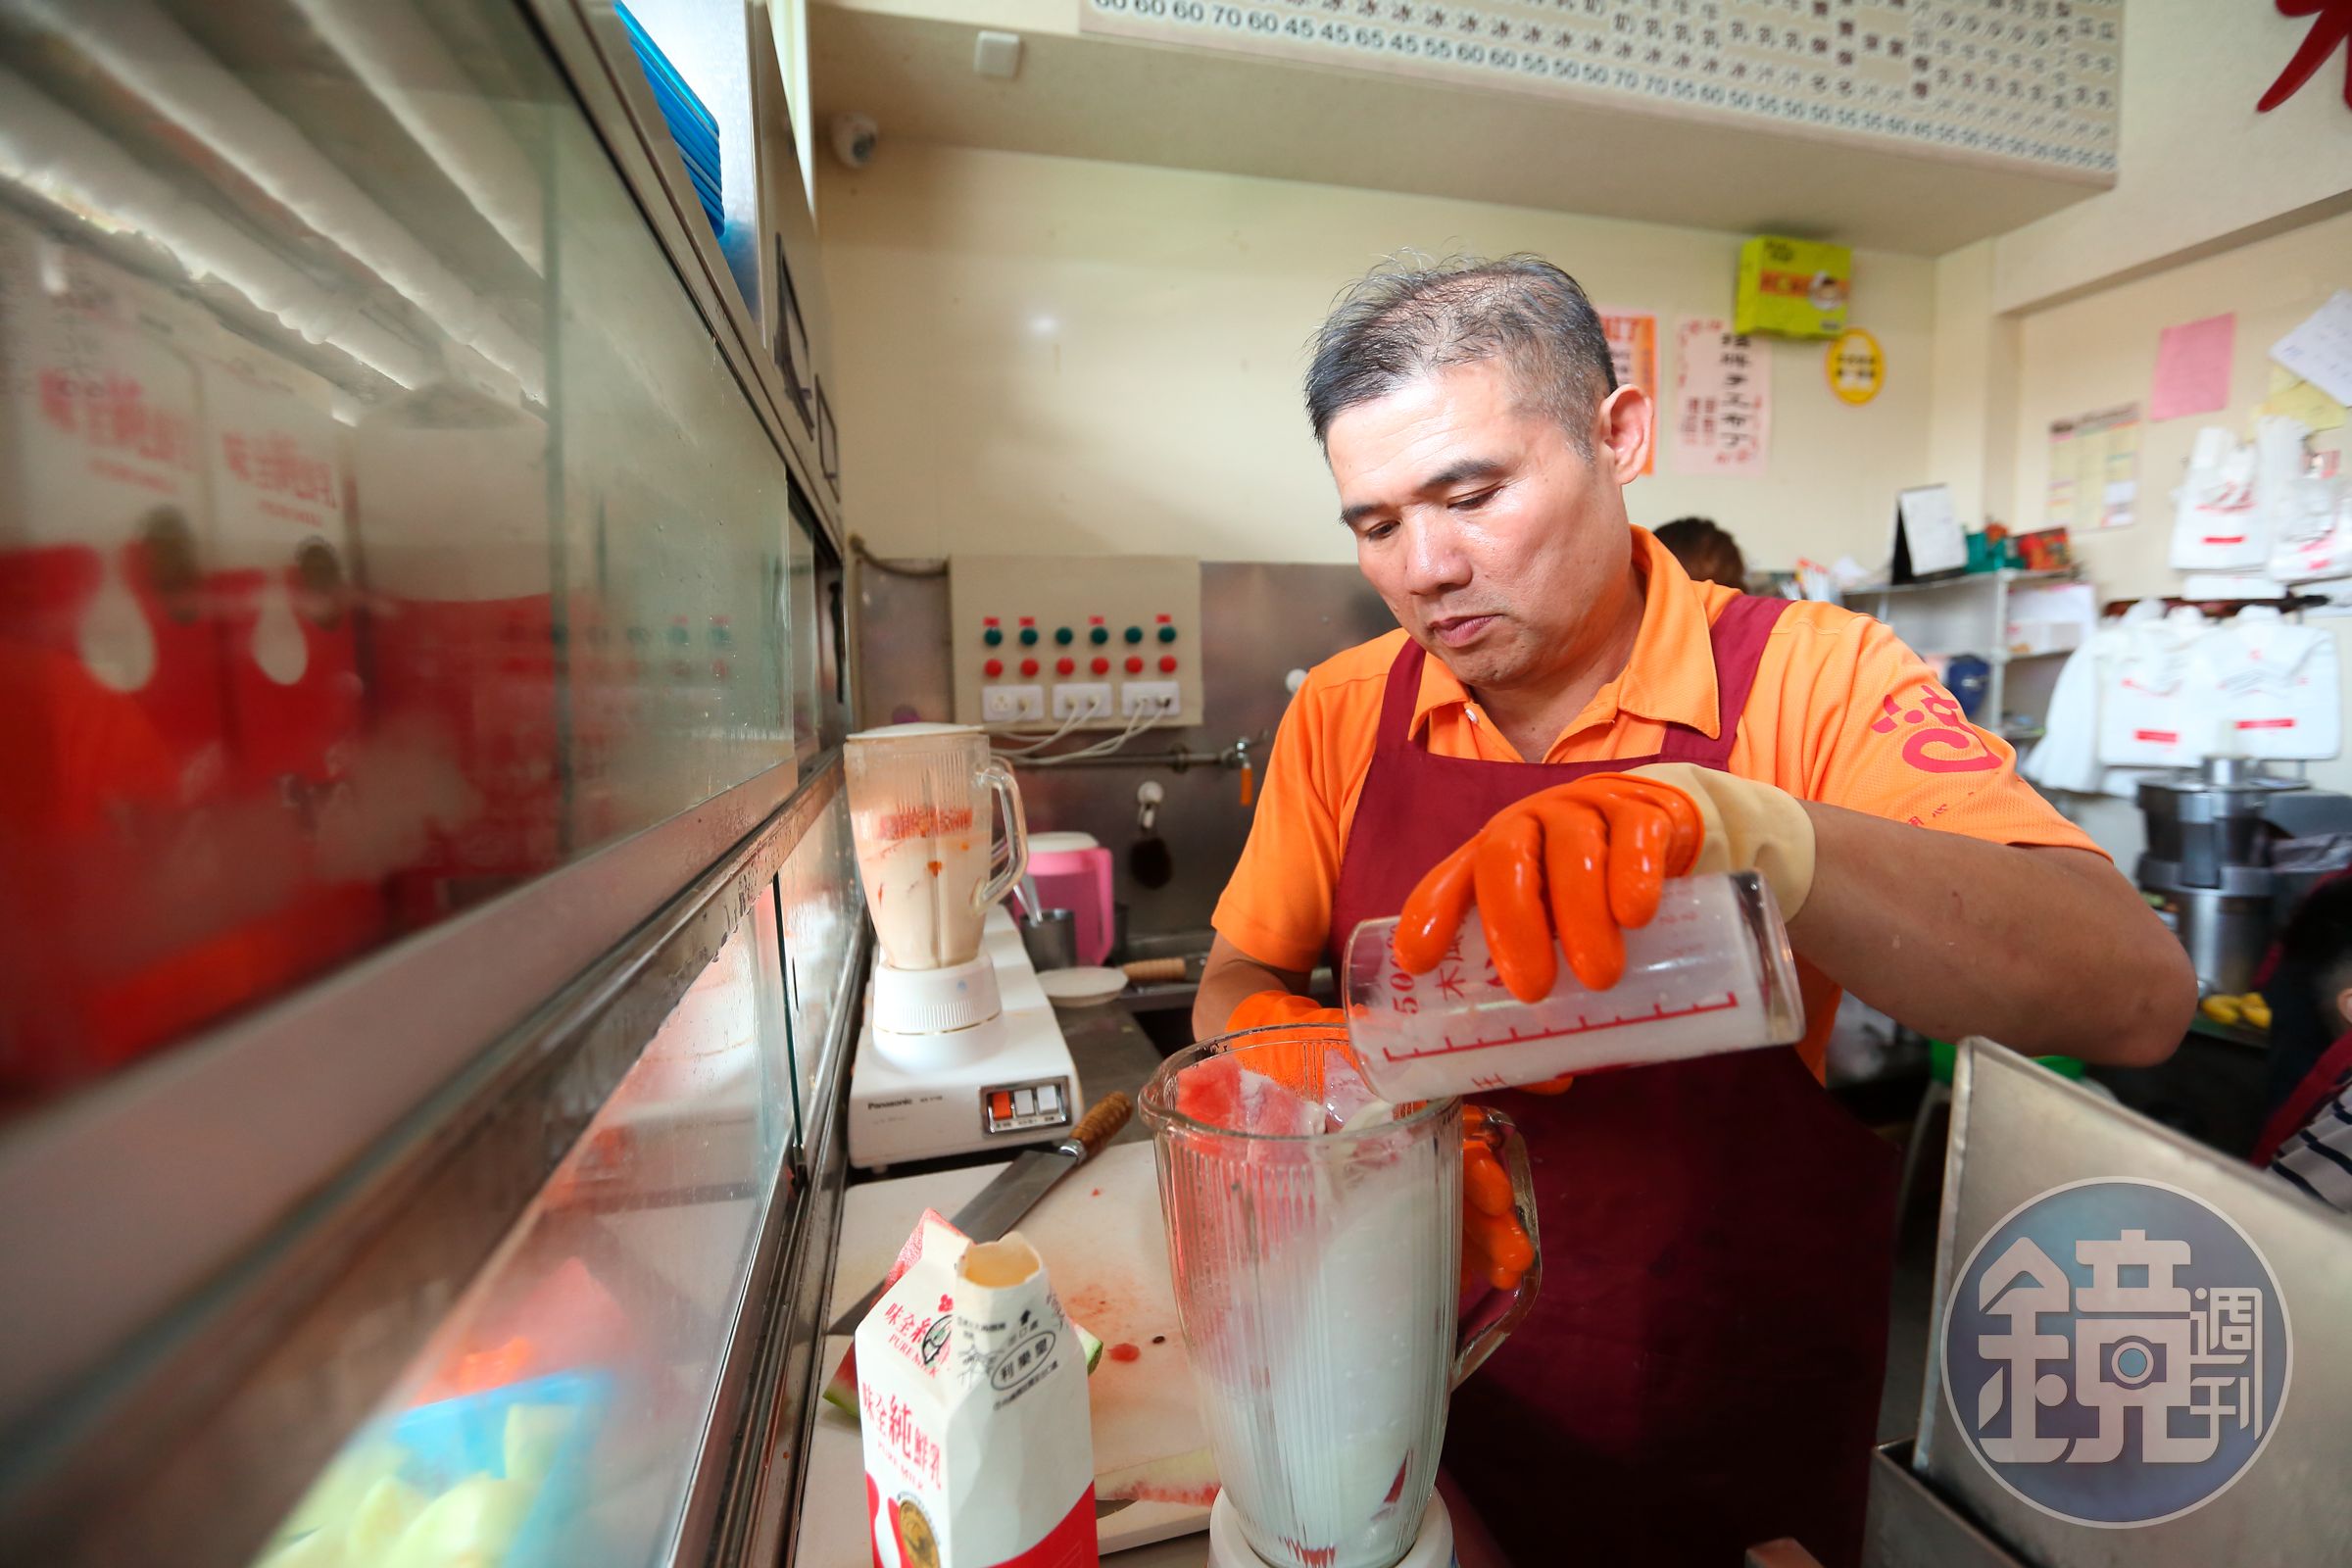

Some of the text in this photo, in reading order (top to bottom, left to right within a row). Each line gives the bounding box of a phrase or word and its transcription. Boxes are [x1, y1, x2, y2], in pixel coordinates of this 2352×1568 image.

[1173, 2, 1204, 22] 60
[1213, 6, 1243, 26] 70
[1249, 11, 1279, 32] 60
[1285, 17, 1315, 37] 45
[1322, 23, 1350, 43] 45
[1355, 27, 1385, 48] 65
[1391, 33, 1420, 53] 45
[867, 1098, 913, 1111] Panasonic
[888, 1334, 912, 1357] PURE
[862, 1382, 942, 1491] 味全純鮮乳
